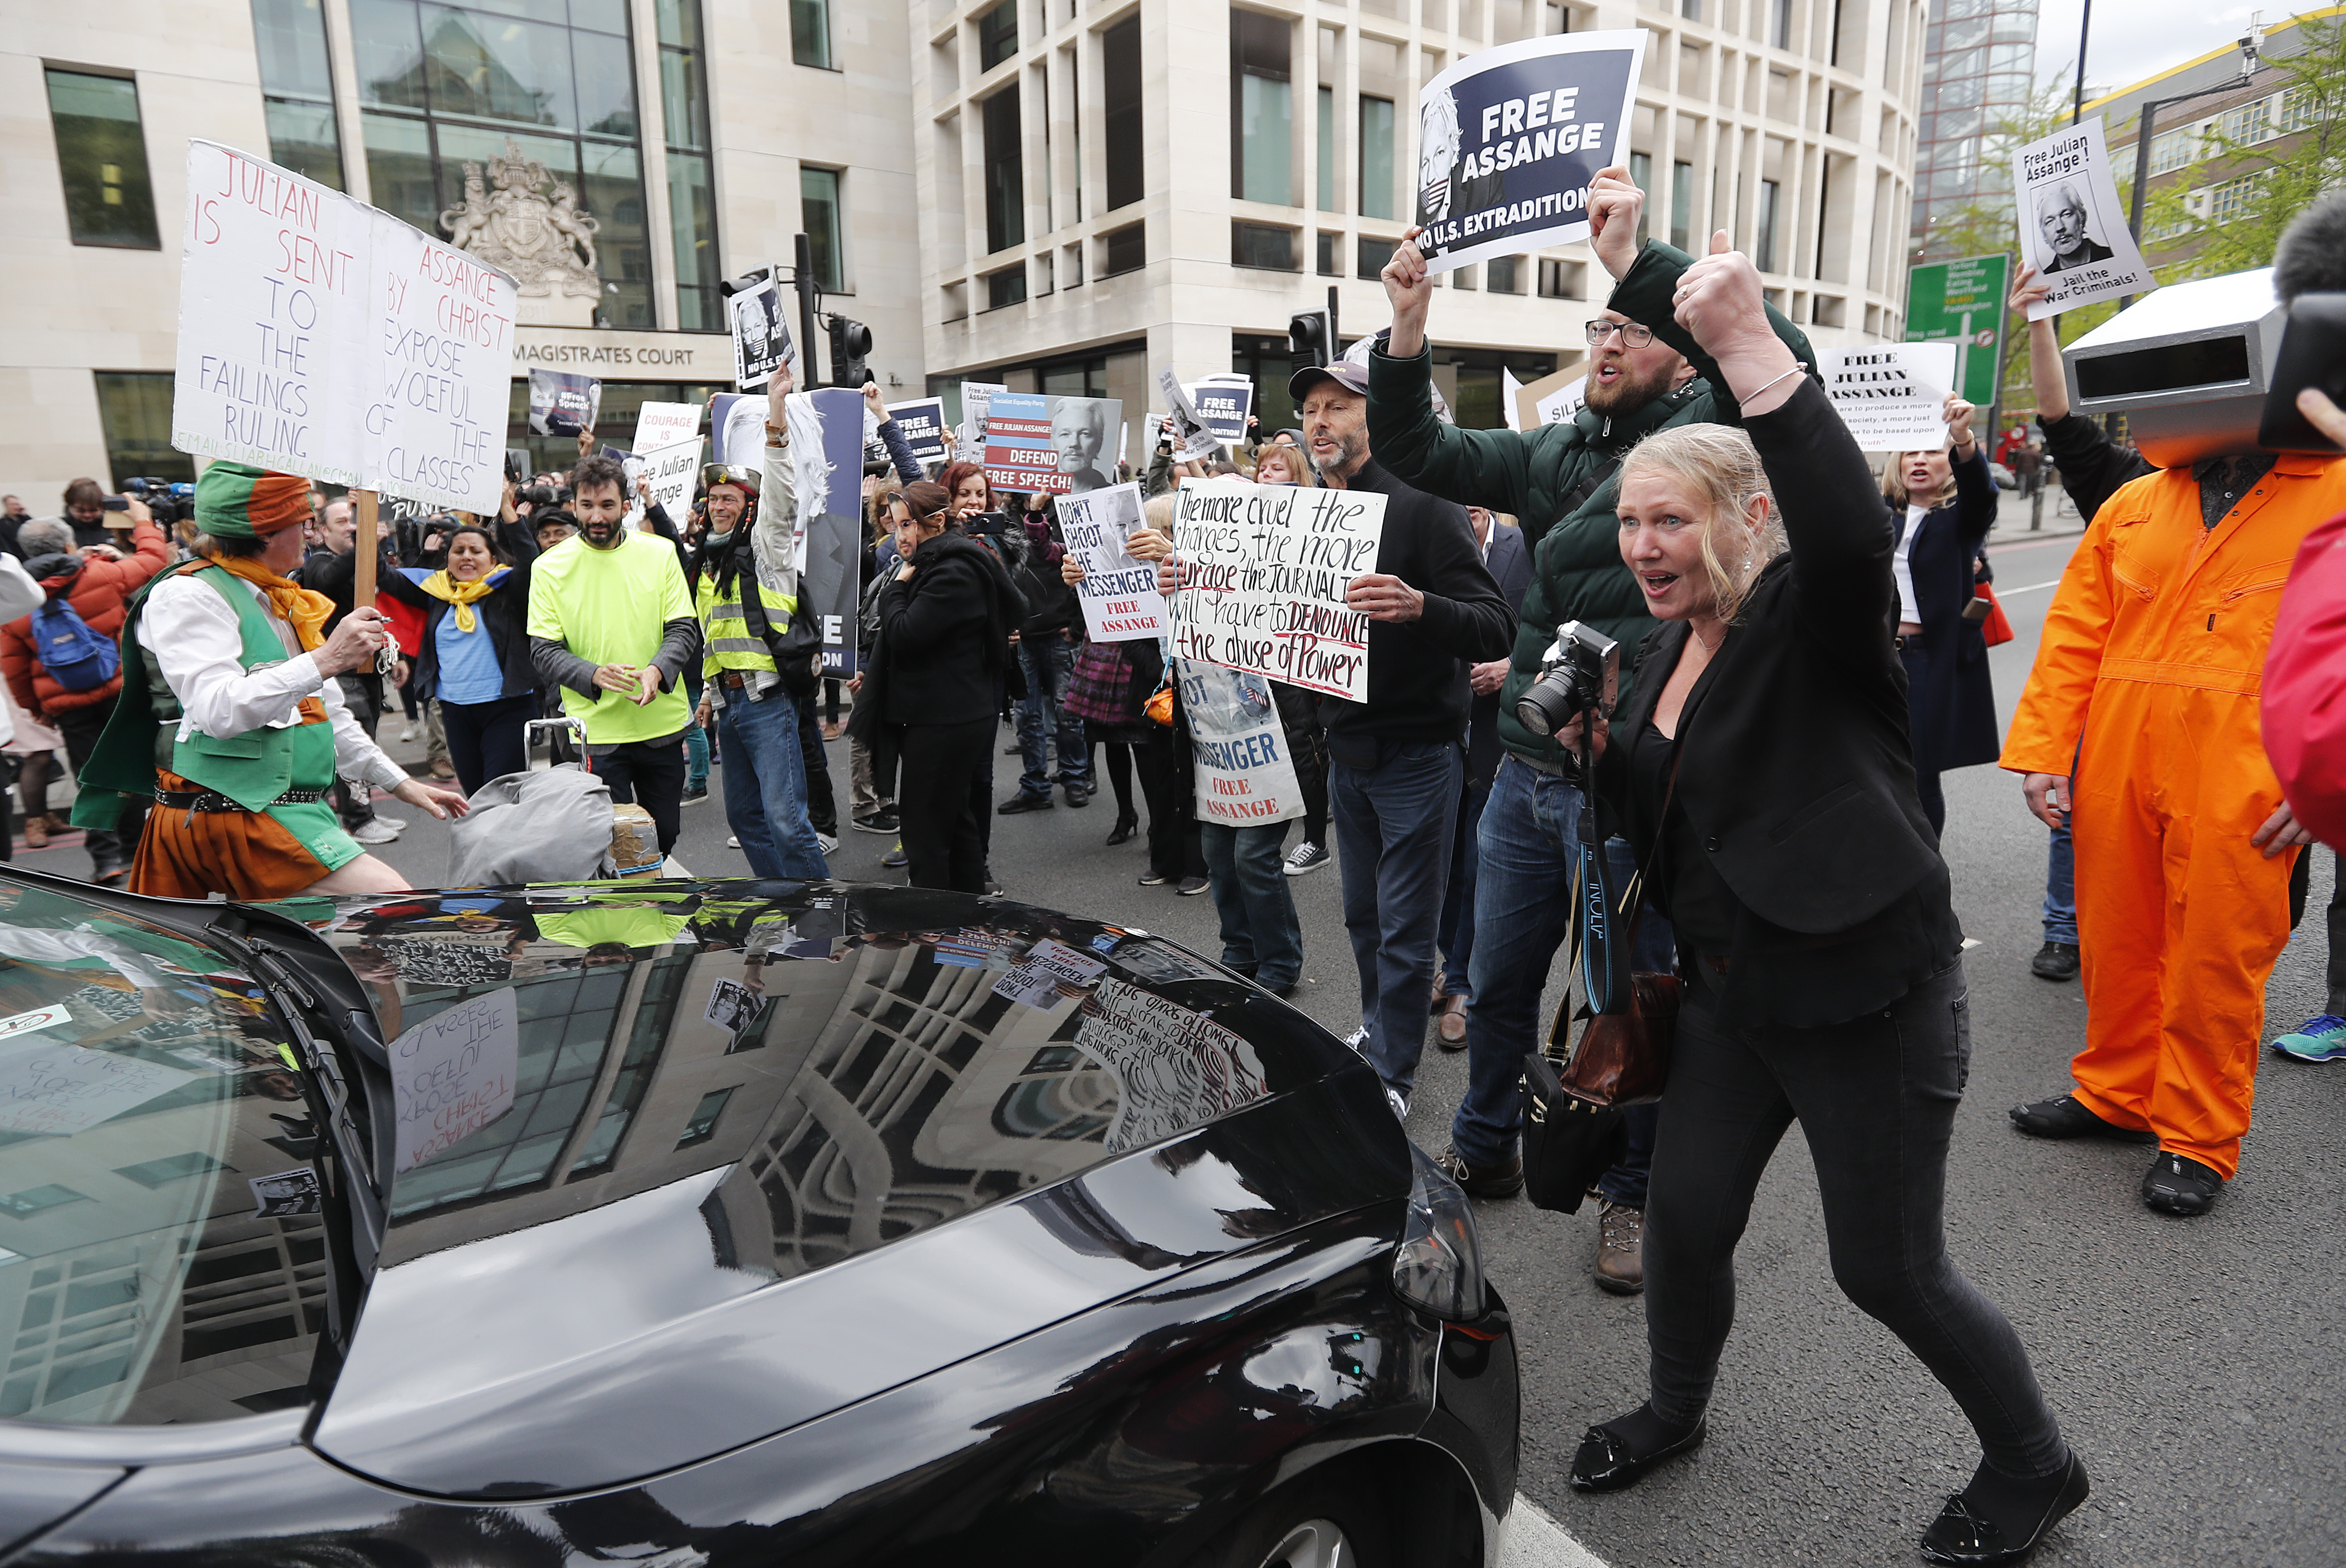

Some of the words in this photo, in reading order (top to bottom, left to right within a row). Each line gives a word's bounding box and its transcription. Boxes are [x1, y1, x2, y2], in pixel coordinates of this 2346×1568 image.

[1481, 86, 1579, 144] FREE
[1461, 122, 1604, 183] ASSANGE
[2023, 151, 2047, 169] Free
[2050, 135, 2088, 158] Julian
[2026, 153, 2078, 184] Assange
[2084, 147, 2090, 163] !
[219, 150, 319, 233] JULIAN
[419, 244, 500, 307] ASSANGE
[1415, 230, 1432, 250] NO
[1433, 219, 1461, 244] U.S.
[1464, 186, 1594, 236] EXTRADITION
[193, 193, 221, 244] IS
[275, 228, 354, 295] SENT
[388, 271, 407, 315] BY
[437, 294, 509, 351] CHRIST
[2063, 273, 2086, 288] Jail
[2086, 268, 2109, 280] the
[2044, 289, 2069, 305] War
[2073, 272, 2139, 297] Criminals!
[263, 276, 317, 330] TO
[384, 318, 466, 377] EXPOSE
[512, 344, 632, 363] MAGISTRATES
[636, 348, 694, 365] COURT
[1844, 352, 1898, 367] FREE
[255, 322, 309, 377] THE
[383, 359, 477, 425] WOEFUL
[748, 362, 759, 374] NO
[760, 357, 775, 370] U.S.
[1835, 369, 1908, 384] JULIAN
[560, 391, 585, 402] #Free
[968, 394, 991, 402] Assang
[1203, 397, 1236, 410] FREE
[1829, 386, 1916, 400] ASSANGE
[200, 355, 308, 417] FAILINGS
[365, 404, 395, 438] OF
[449, 422, 492, 466] THE
[1196, 408, 1243, 421] ASSANGE
[1865, 404, 1900, 413] produce
[645, 414, 693, 428] COURAGE
[897, 415, 930, 431] FREE
[989, 422, 1003, 430] FREE
[1003, 423, 1023, 431] JULIAN
[1023, 424, 1052, 434] ASSANGE!
[660, 430, 670, 441] IS
[904, 426, 940, 441] SANGE
[224, 403, 308, 458] RULING
[387, 447, 474, 495] CLASSES
[912, 445, 942, 455] ADITION
[1009, 449, 1058, 465] DEFEND
[1184, 447, 1196, 455] War
[1195, 438, 1214, 451] Criminals!
[658, 454, 693, 478] Julian
[985, 469, 1015, 485] FREE
[1018, 472, 1072, 490] SPEECH!
[1058, 499, 1094, 525] DON'T
[1180, 487, 1201, 521] The
[1201, 496, 1243, 524] more
[1247, 488, 1295, 529] cruel
[1311, 491, 1365, 533] the
[1064, 524, 1104, 550] SHOOT
[1251, 526, 1293, 564] the
[1299, 533, 1376, 573] more
[1079, 568, 1157, 598] MESSENGER
[1239, 557, 1267, 592] the
[1266, 563, 1353, 604] JOURNALI
[1105, 600, 1141, 615] FREE
[1168, 587, 1200, 626] will
[1213, 590, 1268, 630] have
[1269, 593, 1287, 632] to
[1287, 600, 1369, 644] DENOUNCE
[1101, 616, 1160, 633] ASSANGE
[1177, 625, 1219, 663] the
[1225, 625, 1273, 671] abuse
[1278, 633, 1299, 683] of
[1297, 634, 1363, 689] Power
[1213, 777, 1252, 795] FREE
[1206, 797, 1280, 818] ASSANGE
